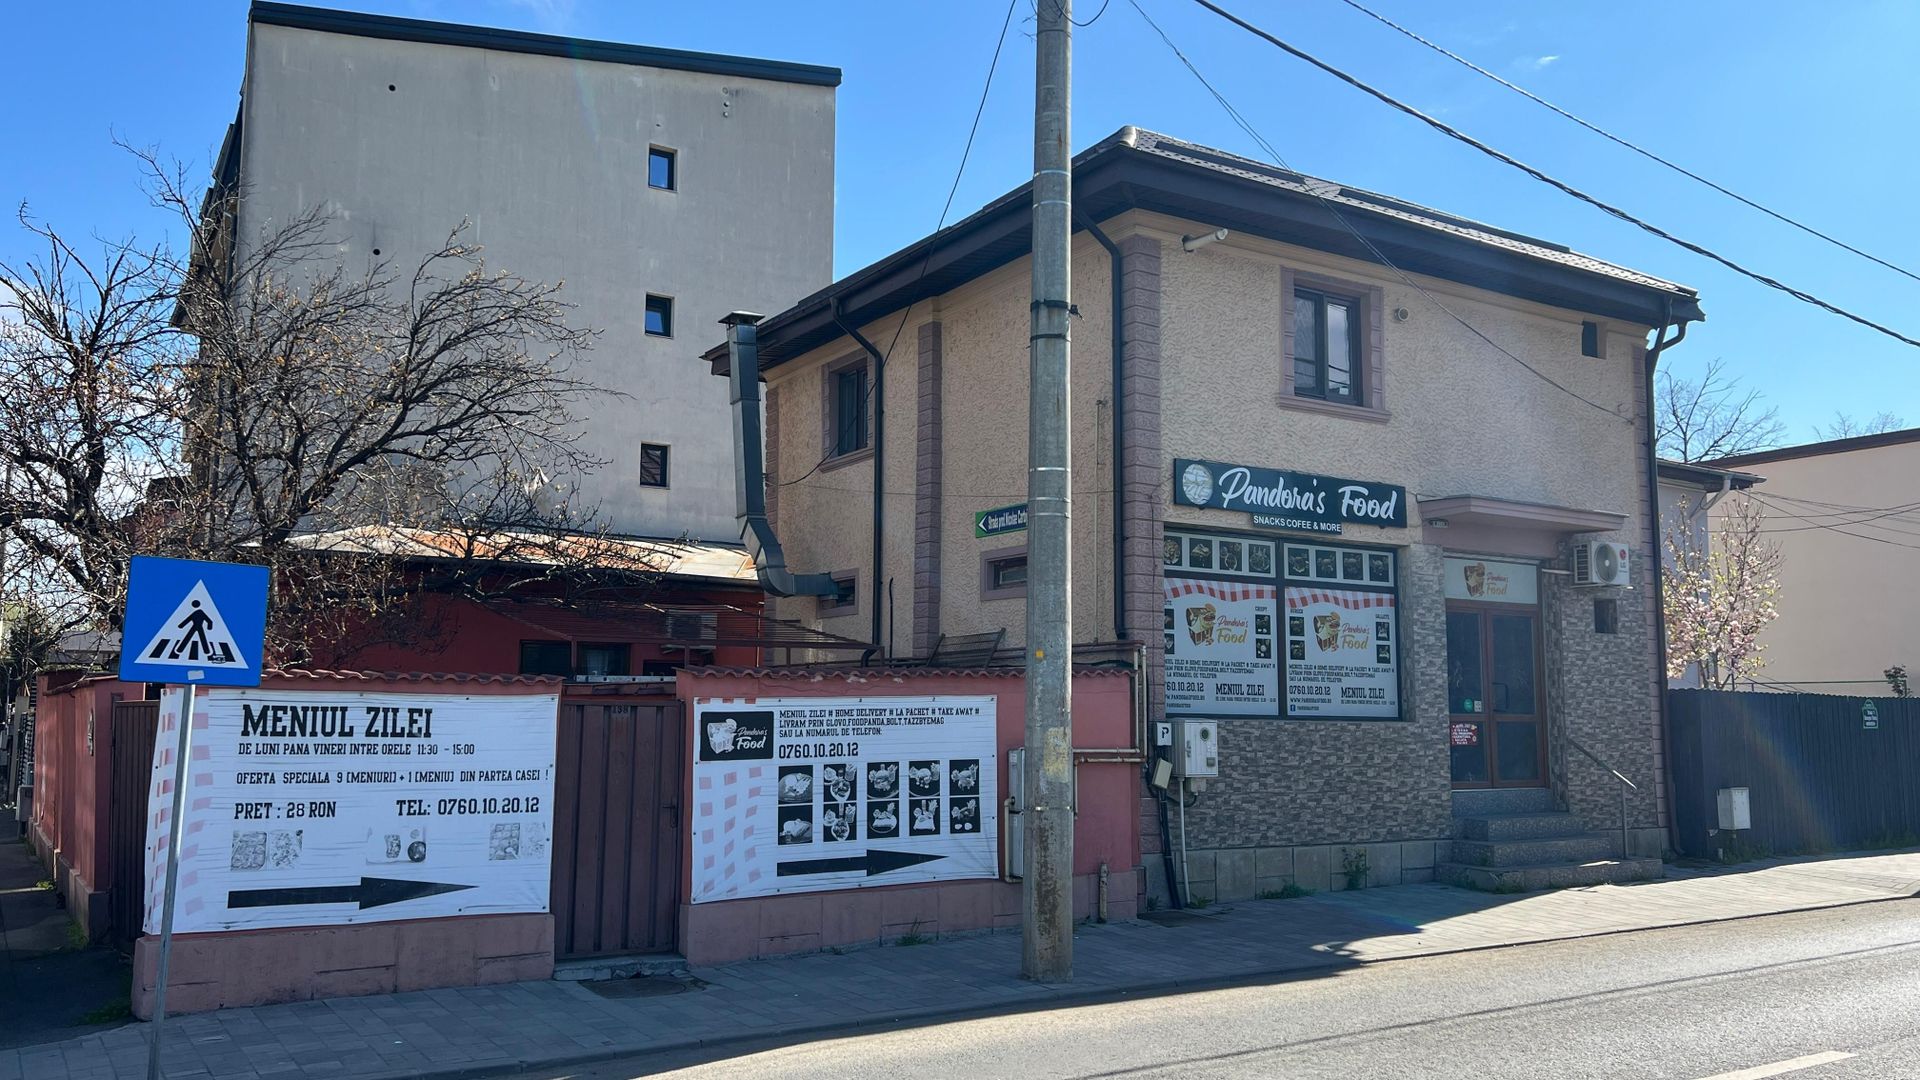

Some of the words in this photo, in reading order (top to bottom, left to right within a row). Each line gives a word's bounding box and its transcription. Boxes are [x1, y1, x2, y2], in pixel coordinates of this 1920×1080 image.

[1218, 467, 1326, 514] Pandora's
[1338, 485, 1398, 520] Food
[1253, 515, 1285, 526] SNACKS
[1286, 519, 1312, 529] COFEE
[1313, 521, 1318, 530] &
[1320, 522, 1341, 532] MORE
[1216, 628, 1248, 644] Food
[1341, 634, 1369, 650] Food
[1216, 683, 1244, 695] MENIUL
[1247, 684, 1264, 696] ZILEI
[1341, 687, 1367, 698] MENIUL
[1368, 688, 1385, 699] ZILEI
[241, 704, 354, 737] MENIUL
[365, 706, 433, 738] ZILEI
[779, 710, 807, 719] MENIUL
[809, 709, 826, 718] ZILEI
[835, 709, 854, 717] HOME
[856, 708, 887, 717] DELIVERY
[896, 708, 904, 716] LA
[906, 708, 930, 716] PACHET
[938, 708, 954, 716] TAKE
[955, 708, 973, 716] AWAY
[779, 720, 806, 728] LIVRAM
[808, 719, 824, 727] PRIN
[779, 729, 793, 738] SAU
[795, 729, 803, 737] LA
[806, 728, 839, 737] NUMARUL
[841, 728, 850, 736] DE
[238, 743, 252, 755] DE
[255, 743, 280, 755] LUNI
[283, 744, 310, 755] PANA
[313, 744, 346, 755] VINERI
[350, 744, 379, 755] INTRE
[382, 744, 411, 755] ORELE
[417, 744, 438, 755] 11:30
[453, 744, 475, 755] 15:00
[736, 736, 766, 750] Food
[779, 742, 858, 759] 0760.10.20.12
[236, 772, 276, 784] OFERTA
[283, 772, 330, 784] SPECIALA
[337, 772, 342, 783] 9
[408, 772, 412, 782] 1
[460, 771, 475, 782] DIN
[479, 770, 512, 782] PARTEA
[516, 770, 540, 781] CASEI
[234, 802, 272, 819] PRET
[286, 802, 305, 818] 28
[308, 801, 336, 818] RON
[396, 800, 430, 816] TEL:
[438, 797, 540, 815] 0760.10.20.12
